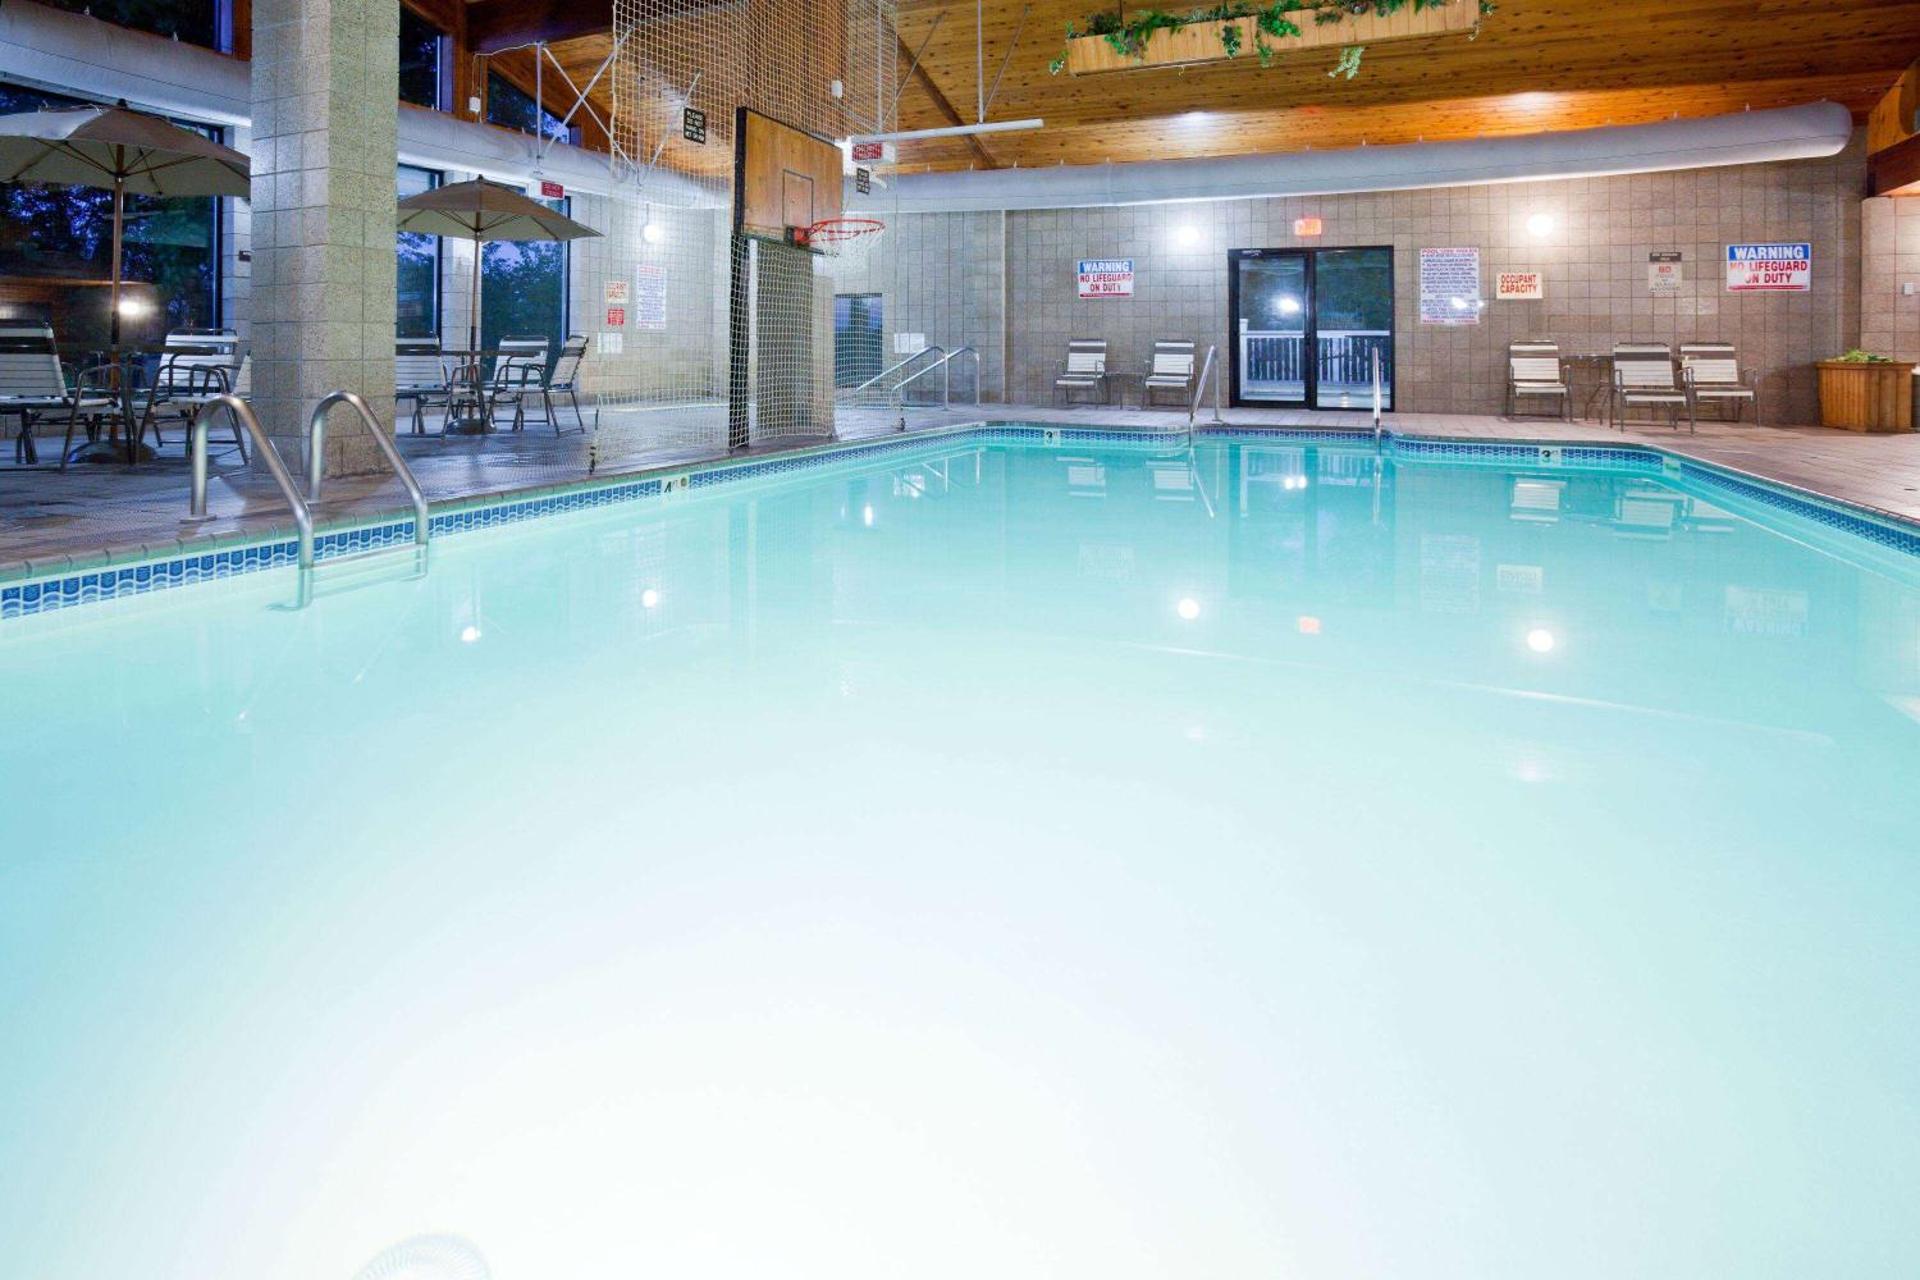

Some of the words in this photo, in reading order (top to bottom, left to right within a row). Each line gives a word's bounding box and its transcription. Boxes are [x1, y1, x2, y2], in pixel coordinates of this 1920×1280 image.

[1734, 246, 1805, 260] WARNING
[1084, 261, 1130, 272] WARNING
[1749, 261, 1808, 272] LIFEGUARD
[1079, 274, 1090, 283] NO
[1501, 274, 1537, 284] OCCUPANT
[1764, 272, 1793, 284] DUTY
[1090, 283, 1100, 292] ON
[1103, 283, 1121, 292] DUTY
[1500, 284, 1537, 294] CAPACITY
